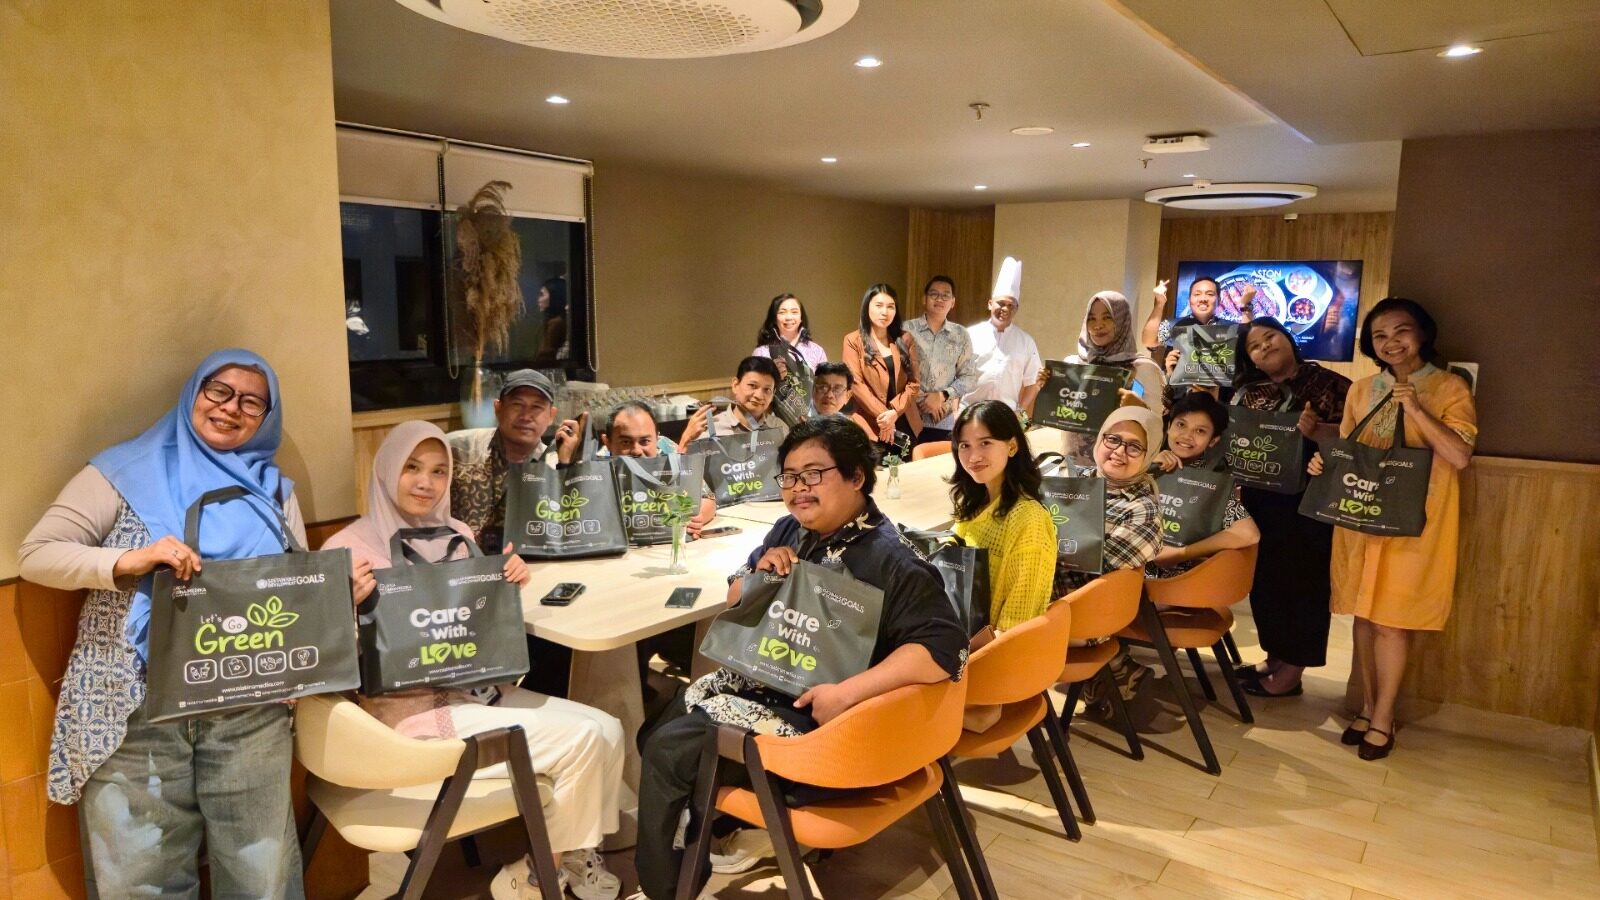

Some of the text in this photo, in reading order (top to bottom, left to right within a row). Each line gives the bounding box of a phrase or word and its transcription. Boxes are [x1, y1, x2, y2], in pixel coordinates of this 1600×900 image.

[1251, 269, 1282, 278] ASTON
[1230, 439, 1267, 461] Green
[721, 460, 756, 475] Care
[621, 495, 669, 513] Green
[1068, 493, 1091, 501] GOALS
[1159, 493, 1184, 508] are
[536, 499, 580, 522] Green
[296, 573, 325, 585] GOALS
[841, 597, 864, 613] GOALS
[200, 613, 223, 625] Let's
[409, 606, 472, 628] Care
[768, 600, 820, 633] Care
[228, 618, 242, 631] Go
[195, 623, 285, 655] Green
